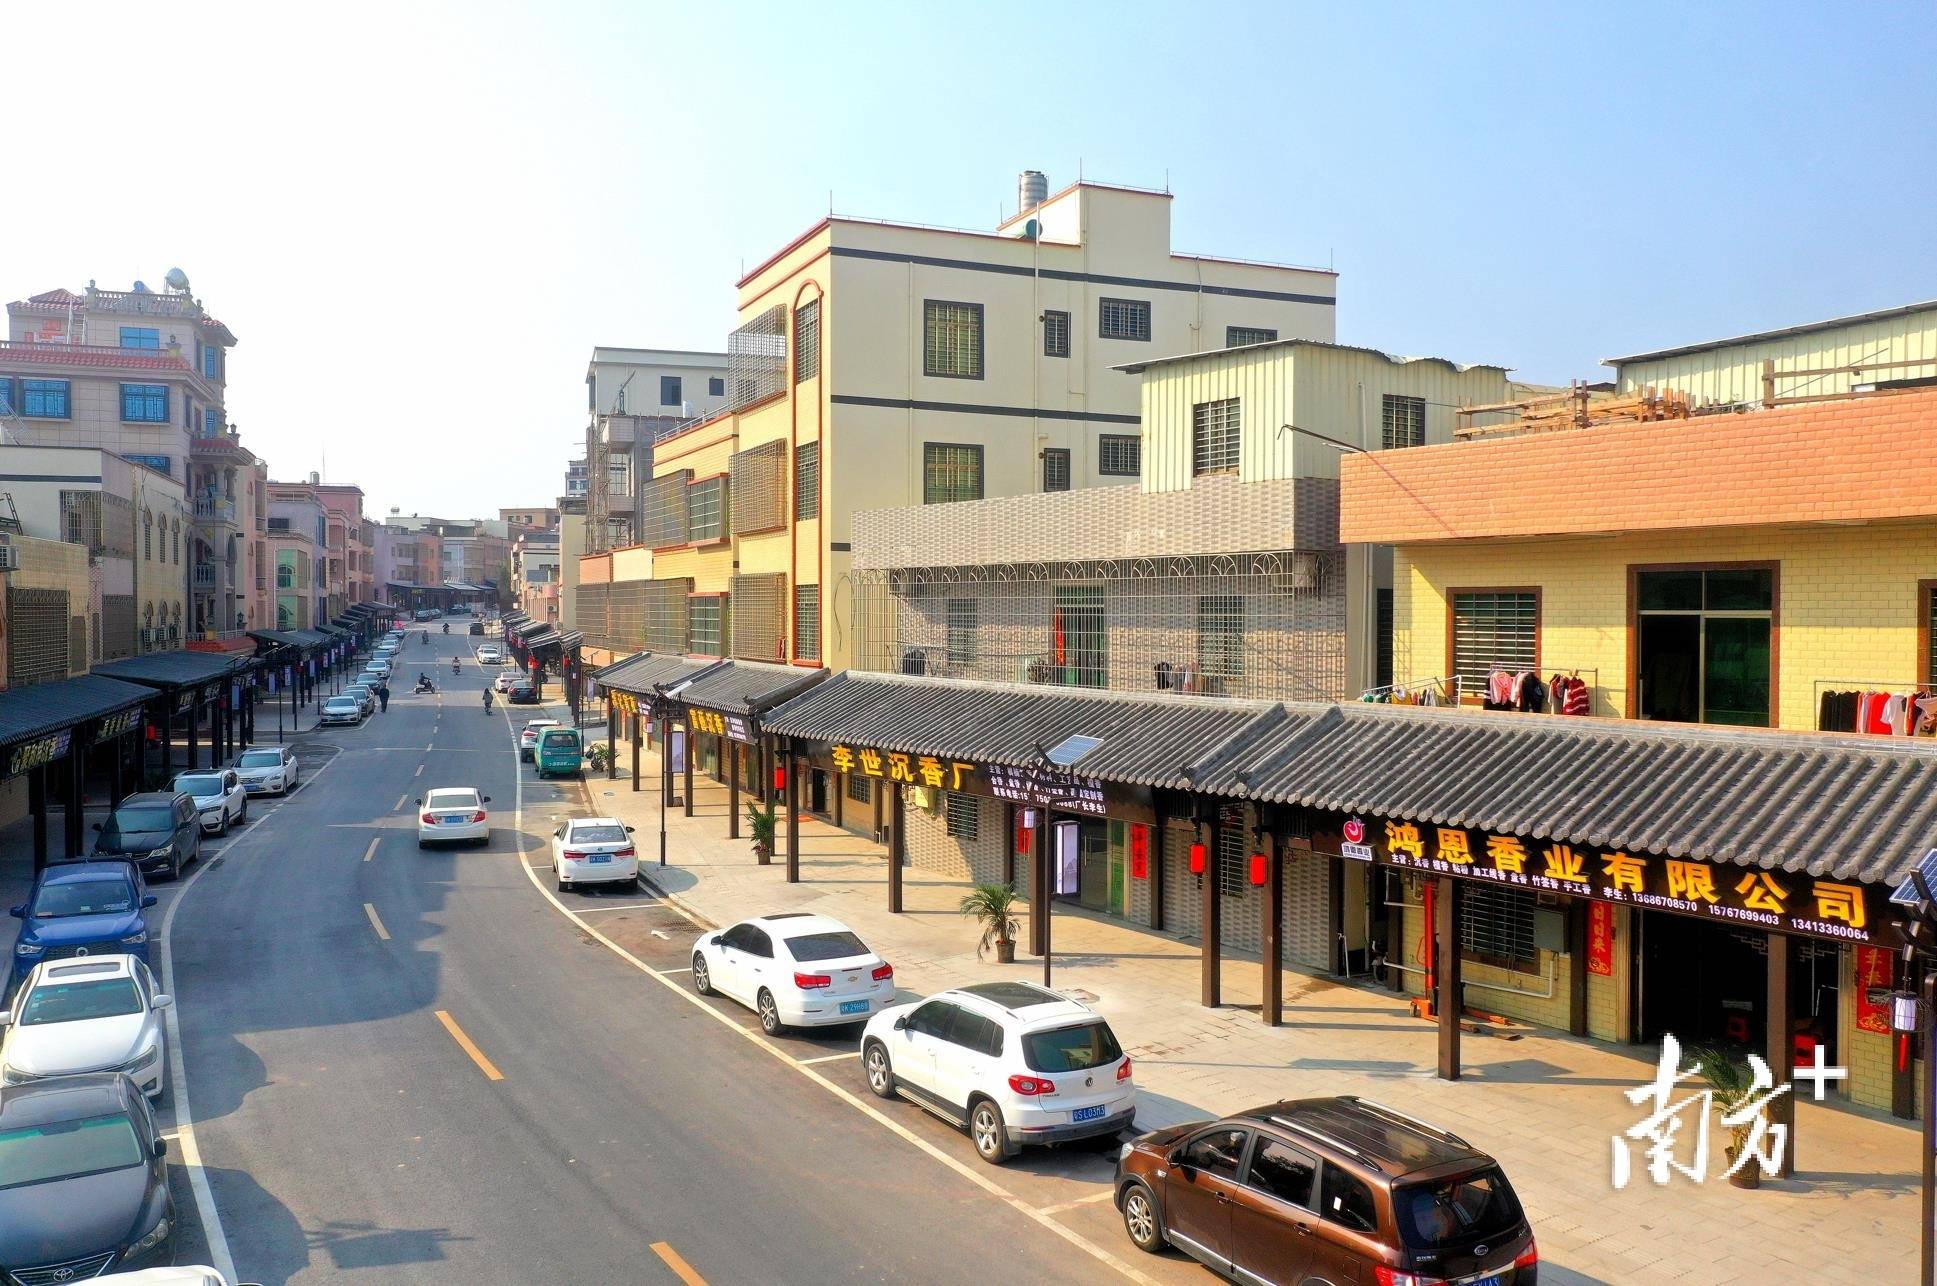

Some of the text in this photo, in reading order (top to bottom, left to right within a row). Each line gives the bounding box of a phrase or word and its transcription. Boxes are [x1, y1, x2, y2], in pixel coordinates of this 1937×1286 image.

[831, 744, 976, 790] 李世沉香厂
[1384, 820, 1867, 928] 鸿恩香业有限公司
[1708, 904, 1780, 926] 15767699403
[1791, 918, 1869, 941] 13413360064
